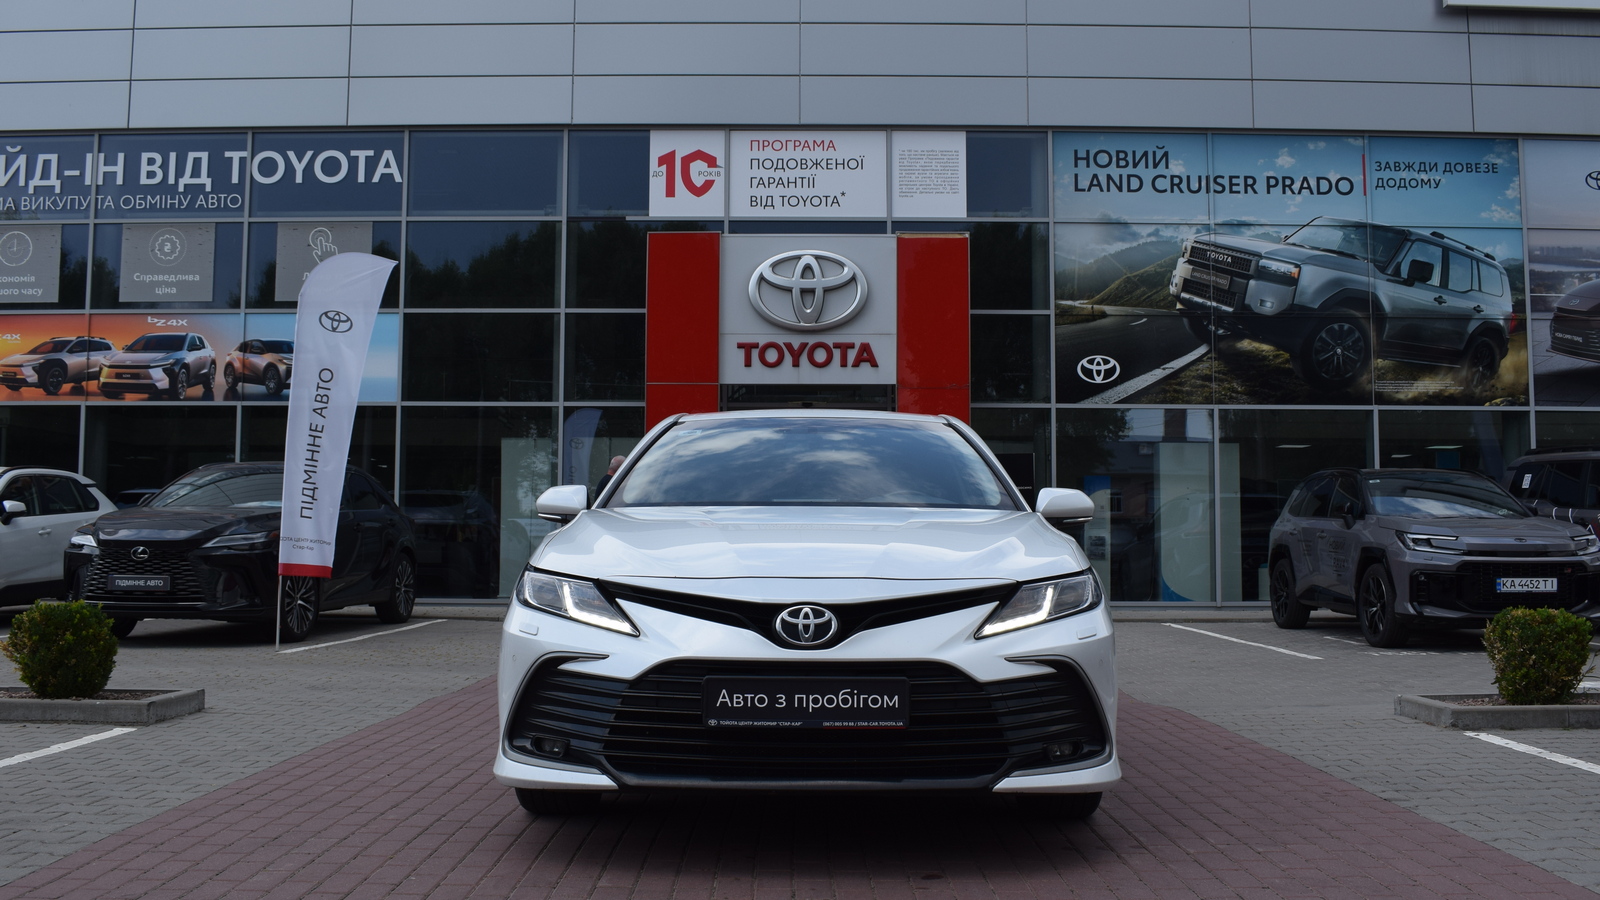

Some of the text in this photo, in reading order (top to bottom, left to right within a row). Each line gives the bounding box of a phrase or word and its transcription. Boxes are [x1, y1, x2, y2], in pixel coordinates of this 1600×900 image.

[750, 139, 836, 152] ПРОГРАМА
[750, 155, 865, 172] ПОДОВЖЕНОЇ
[1073, 145, 1169, 169] НОВИЙ
[139, 151, 212, 192] ВІД
[224, 150, 403, 185] TOYOTA
[652, 170, 664, 178] ДО
[698, 170, 722, 178] РОКІВ
[1374, 161, 1498, 175] ЗАВЖДИ ДОВЕЗЕ
[750, 173, 817, 189] ГАРАНТІЇ
[1074, 173, 1354, 196] LAND CRUISER PRADO
[1375, 177, 1442, 190] ДОДОМУ
[21, 195, 91, 210] ВИКУПУ
[96, 195, 115, 210] ТА
[120, 194, 192, 209] ОБМІНУ
[195, 193, 242, 209] АВТО
[750, 195, 775, 210] ВІД
[1206, 251, 1232, 263] TOYOTA
[133, 272, 200, 283] Справедлива
[21, 288, 43, 297] часу
[155, 284, 177, 295] ціна
[737, 341, 880, 368] TOYOTA
[300, 367, 334, 519] ПІДМІННЕ АВТО
[115, 579, 164, 587] ПІДМІННЕ АВТО
[1502, 579, 1516, 589] KA
[1518, 579, 1541, 589] 4452
[716, 689, 899, 713] Авто з пробігом
